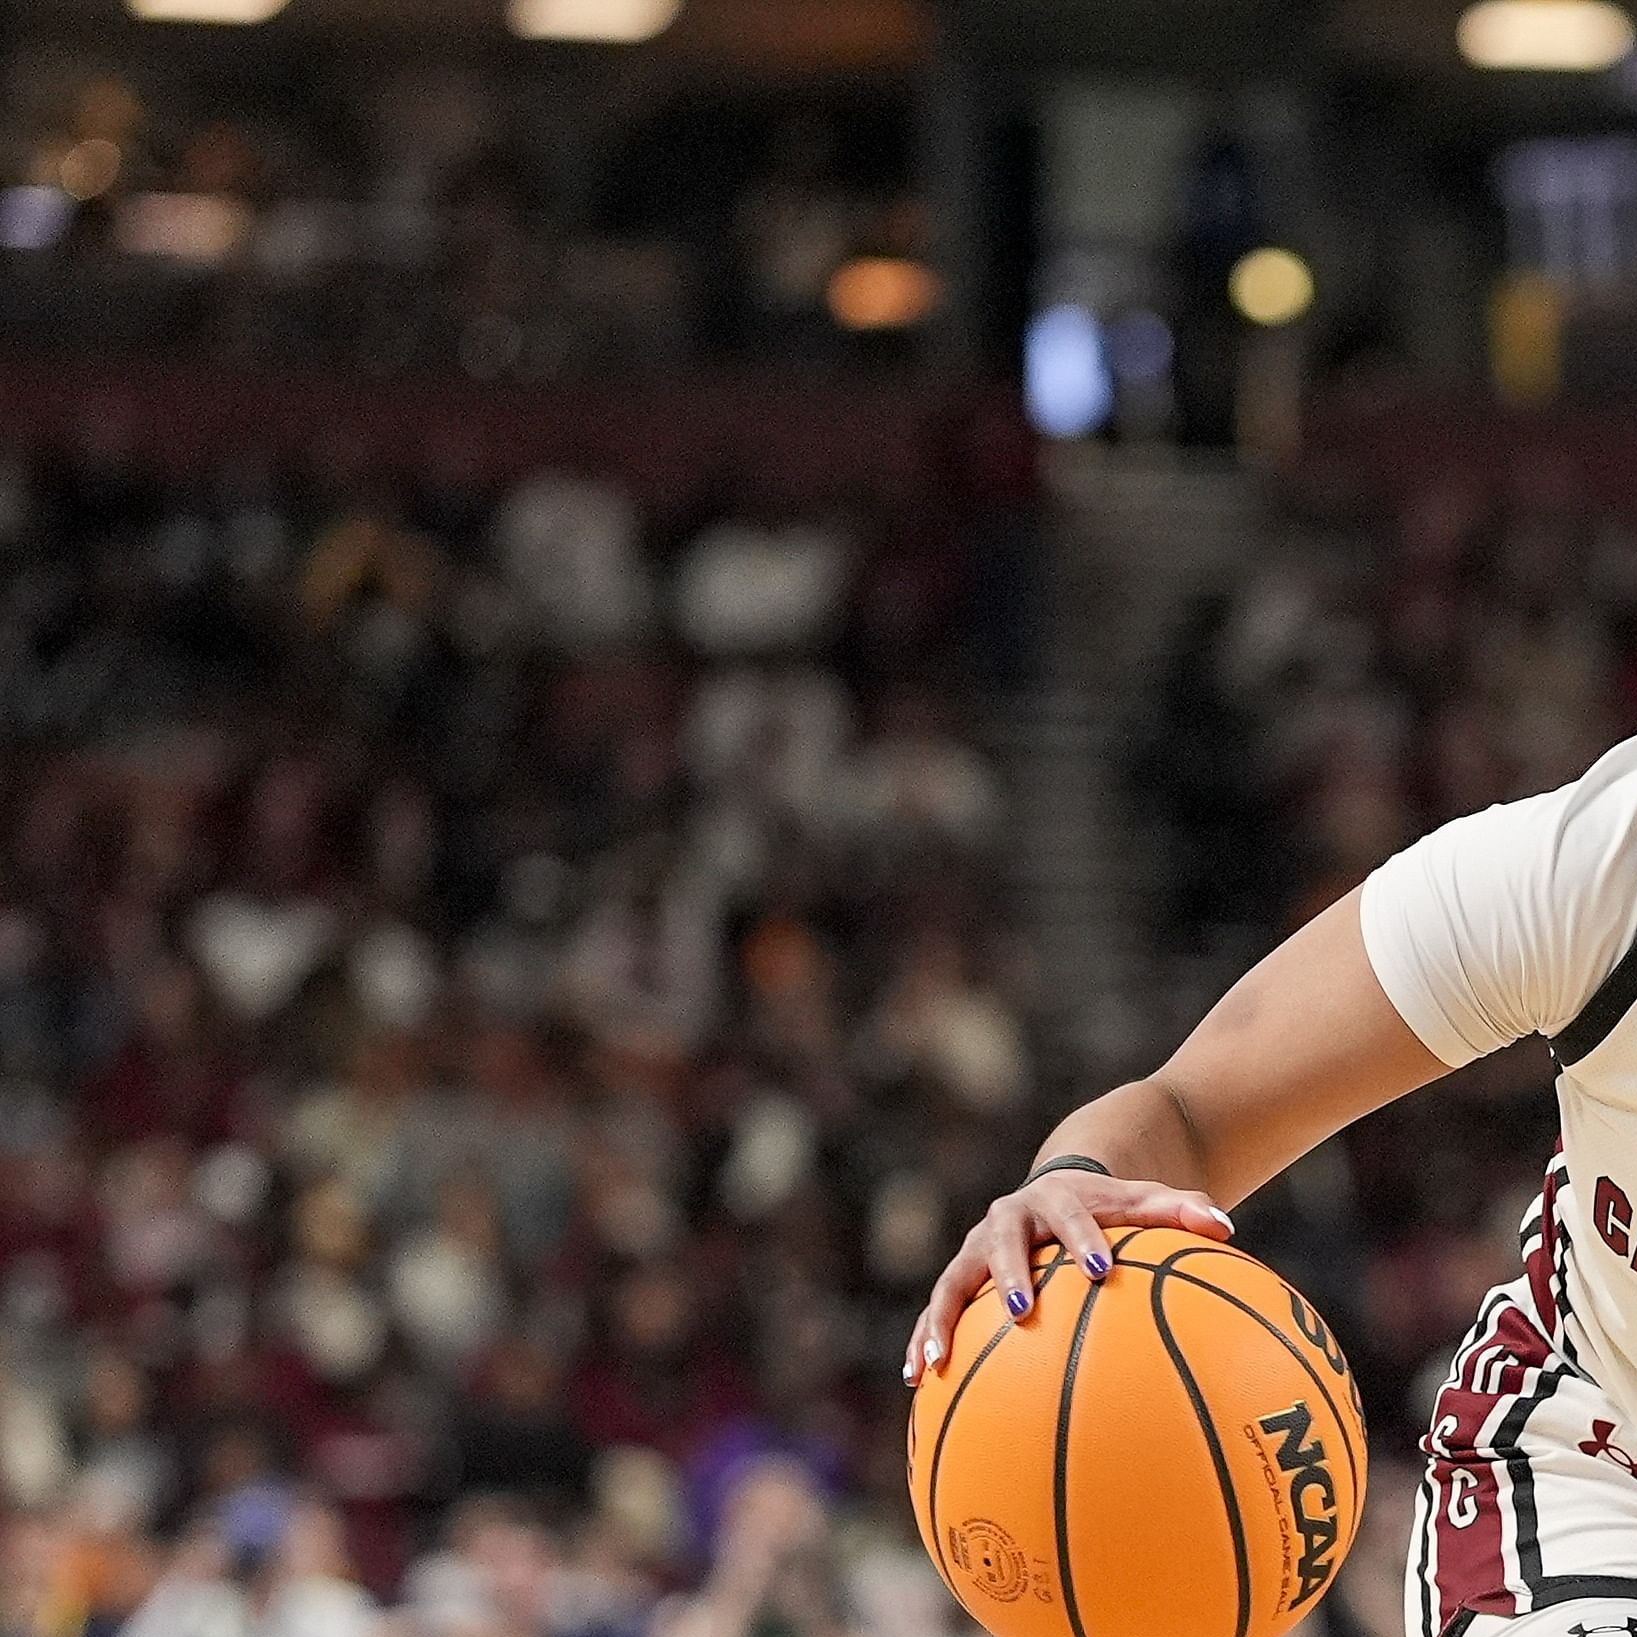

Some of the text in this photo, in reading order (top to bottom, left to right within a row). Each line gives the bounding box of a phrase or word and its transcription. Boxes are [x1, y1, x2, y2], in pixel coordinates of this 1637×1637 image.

[1243, 1423, 1291, 1620] OFFICIAL GAME BALL
[1256, 1399, 1338, 1612] NCAA
